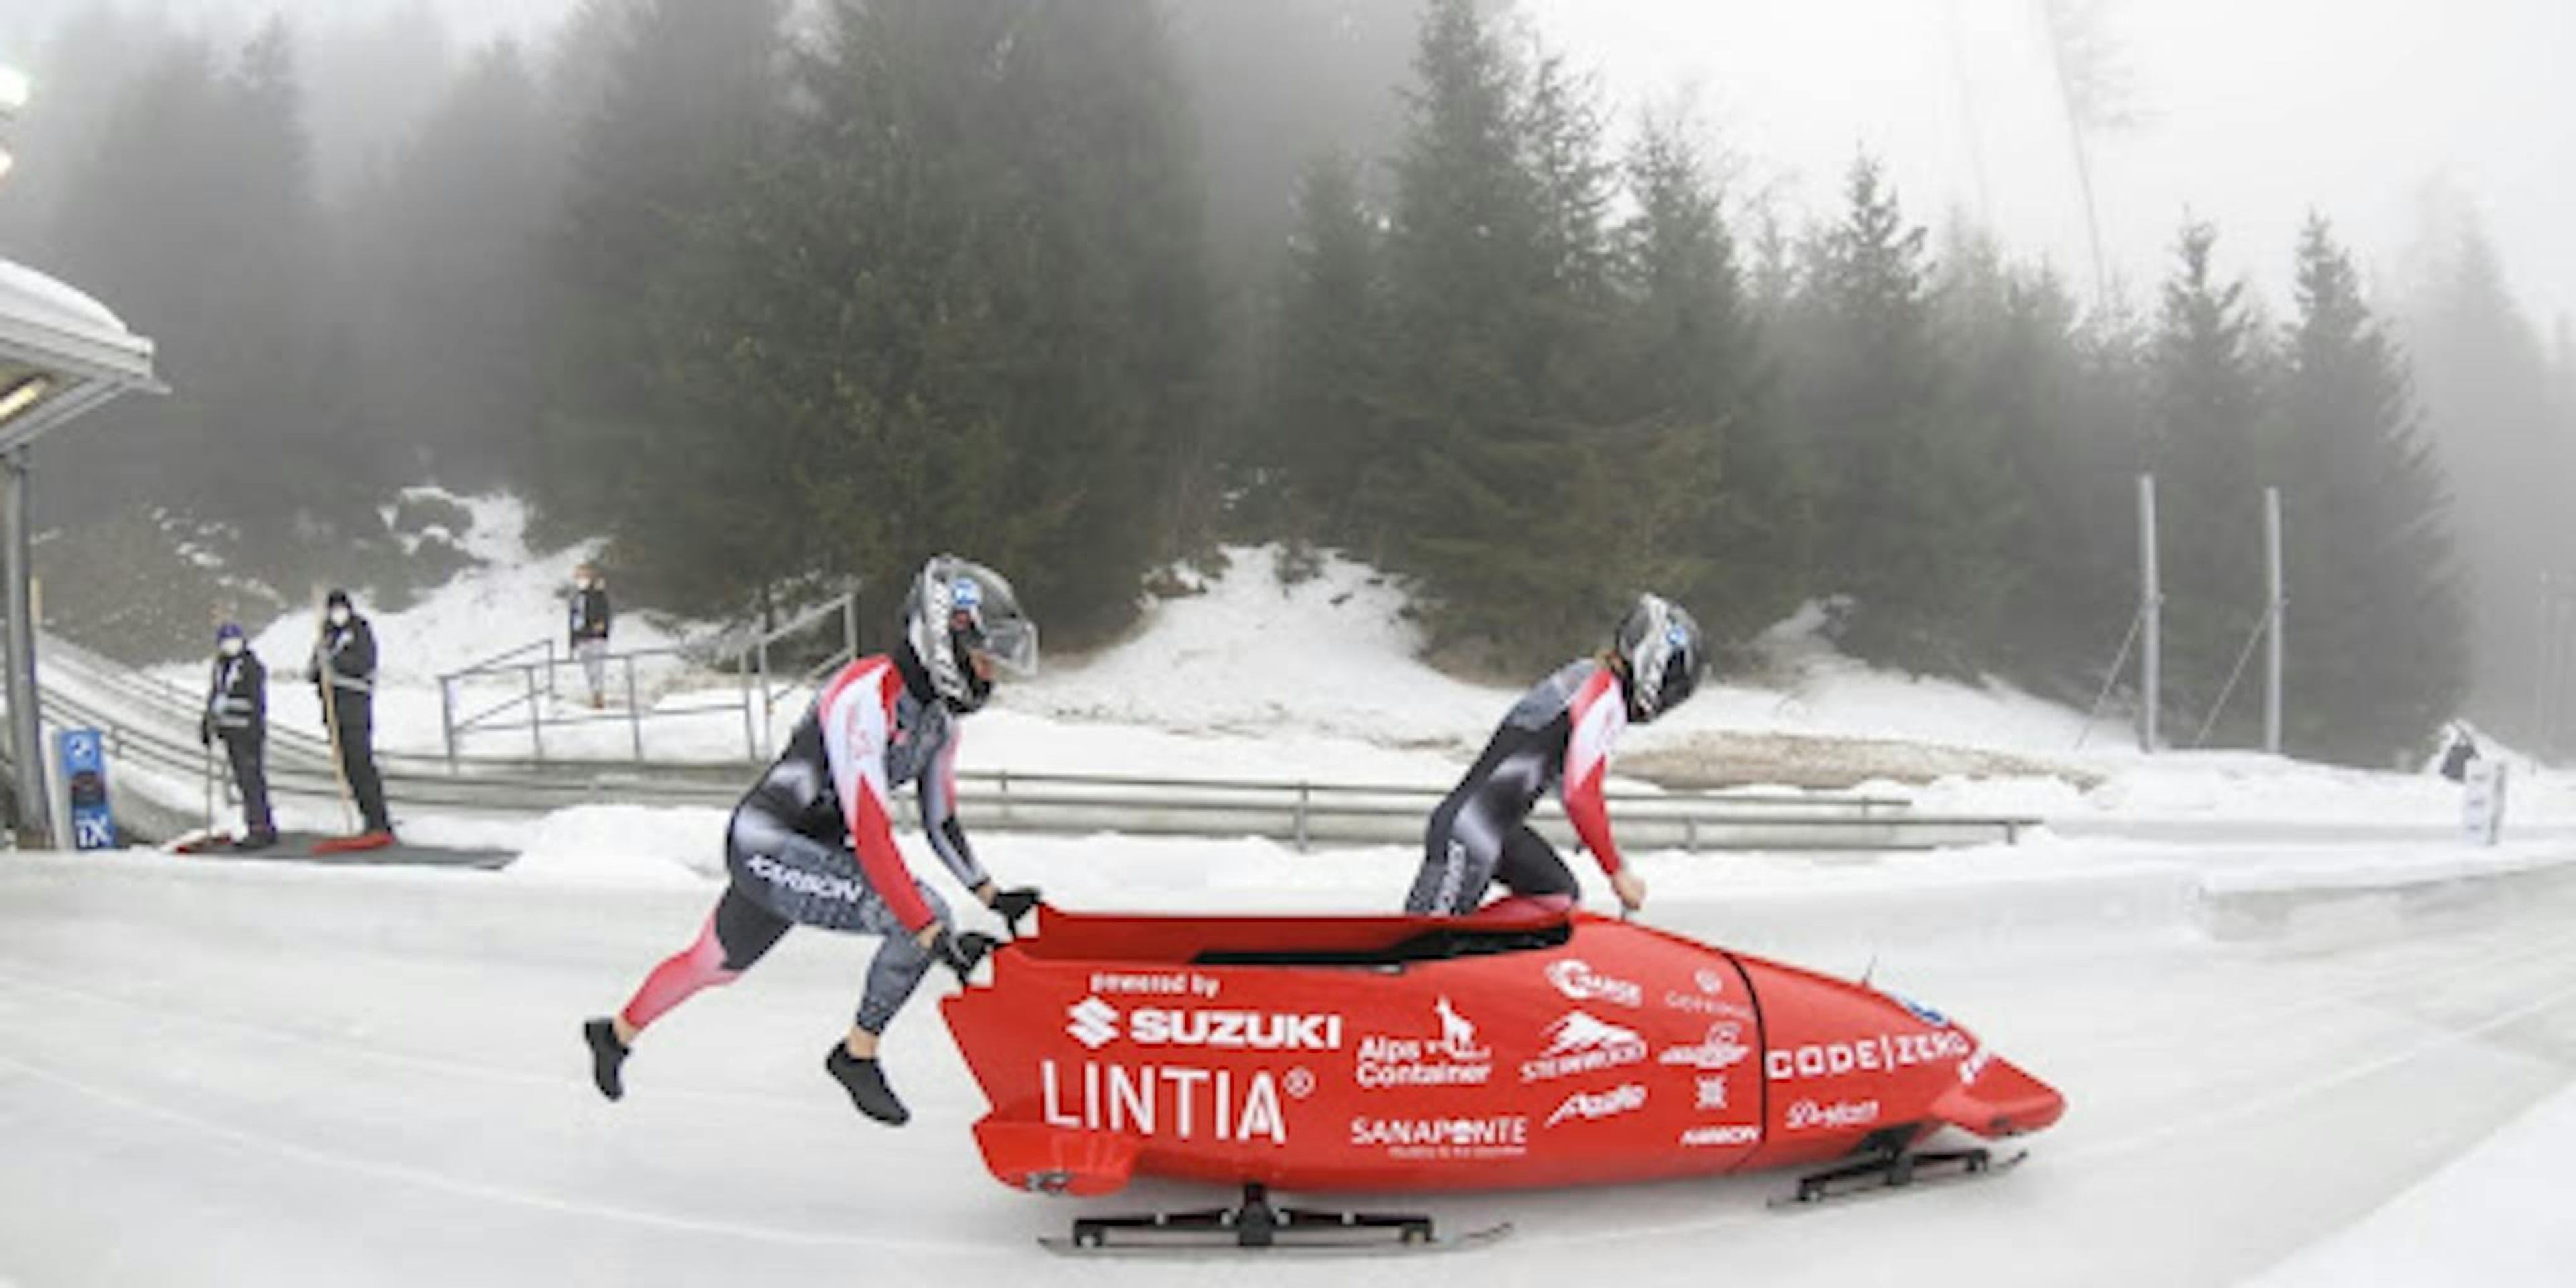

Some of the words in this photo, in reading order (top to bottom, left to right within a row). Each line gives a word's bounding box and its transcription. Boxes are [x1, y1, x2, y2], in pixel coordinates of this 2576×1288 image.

[1090, 973, 1187, 994] powered
[1191, 973, 1220, 998] by
[1130, 1008, 1342, 1049] SUZUKI
[1358, 1036, 1421, 1065] Alps
[1356, 1062, 1492, 1088] Container
